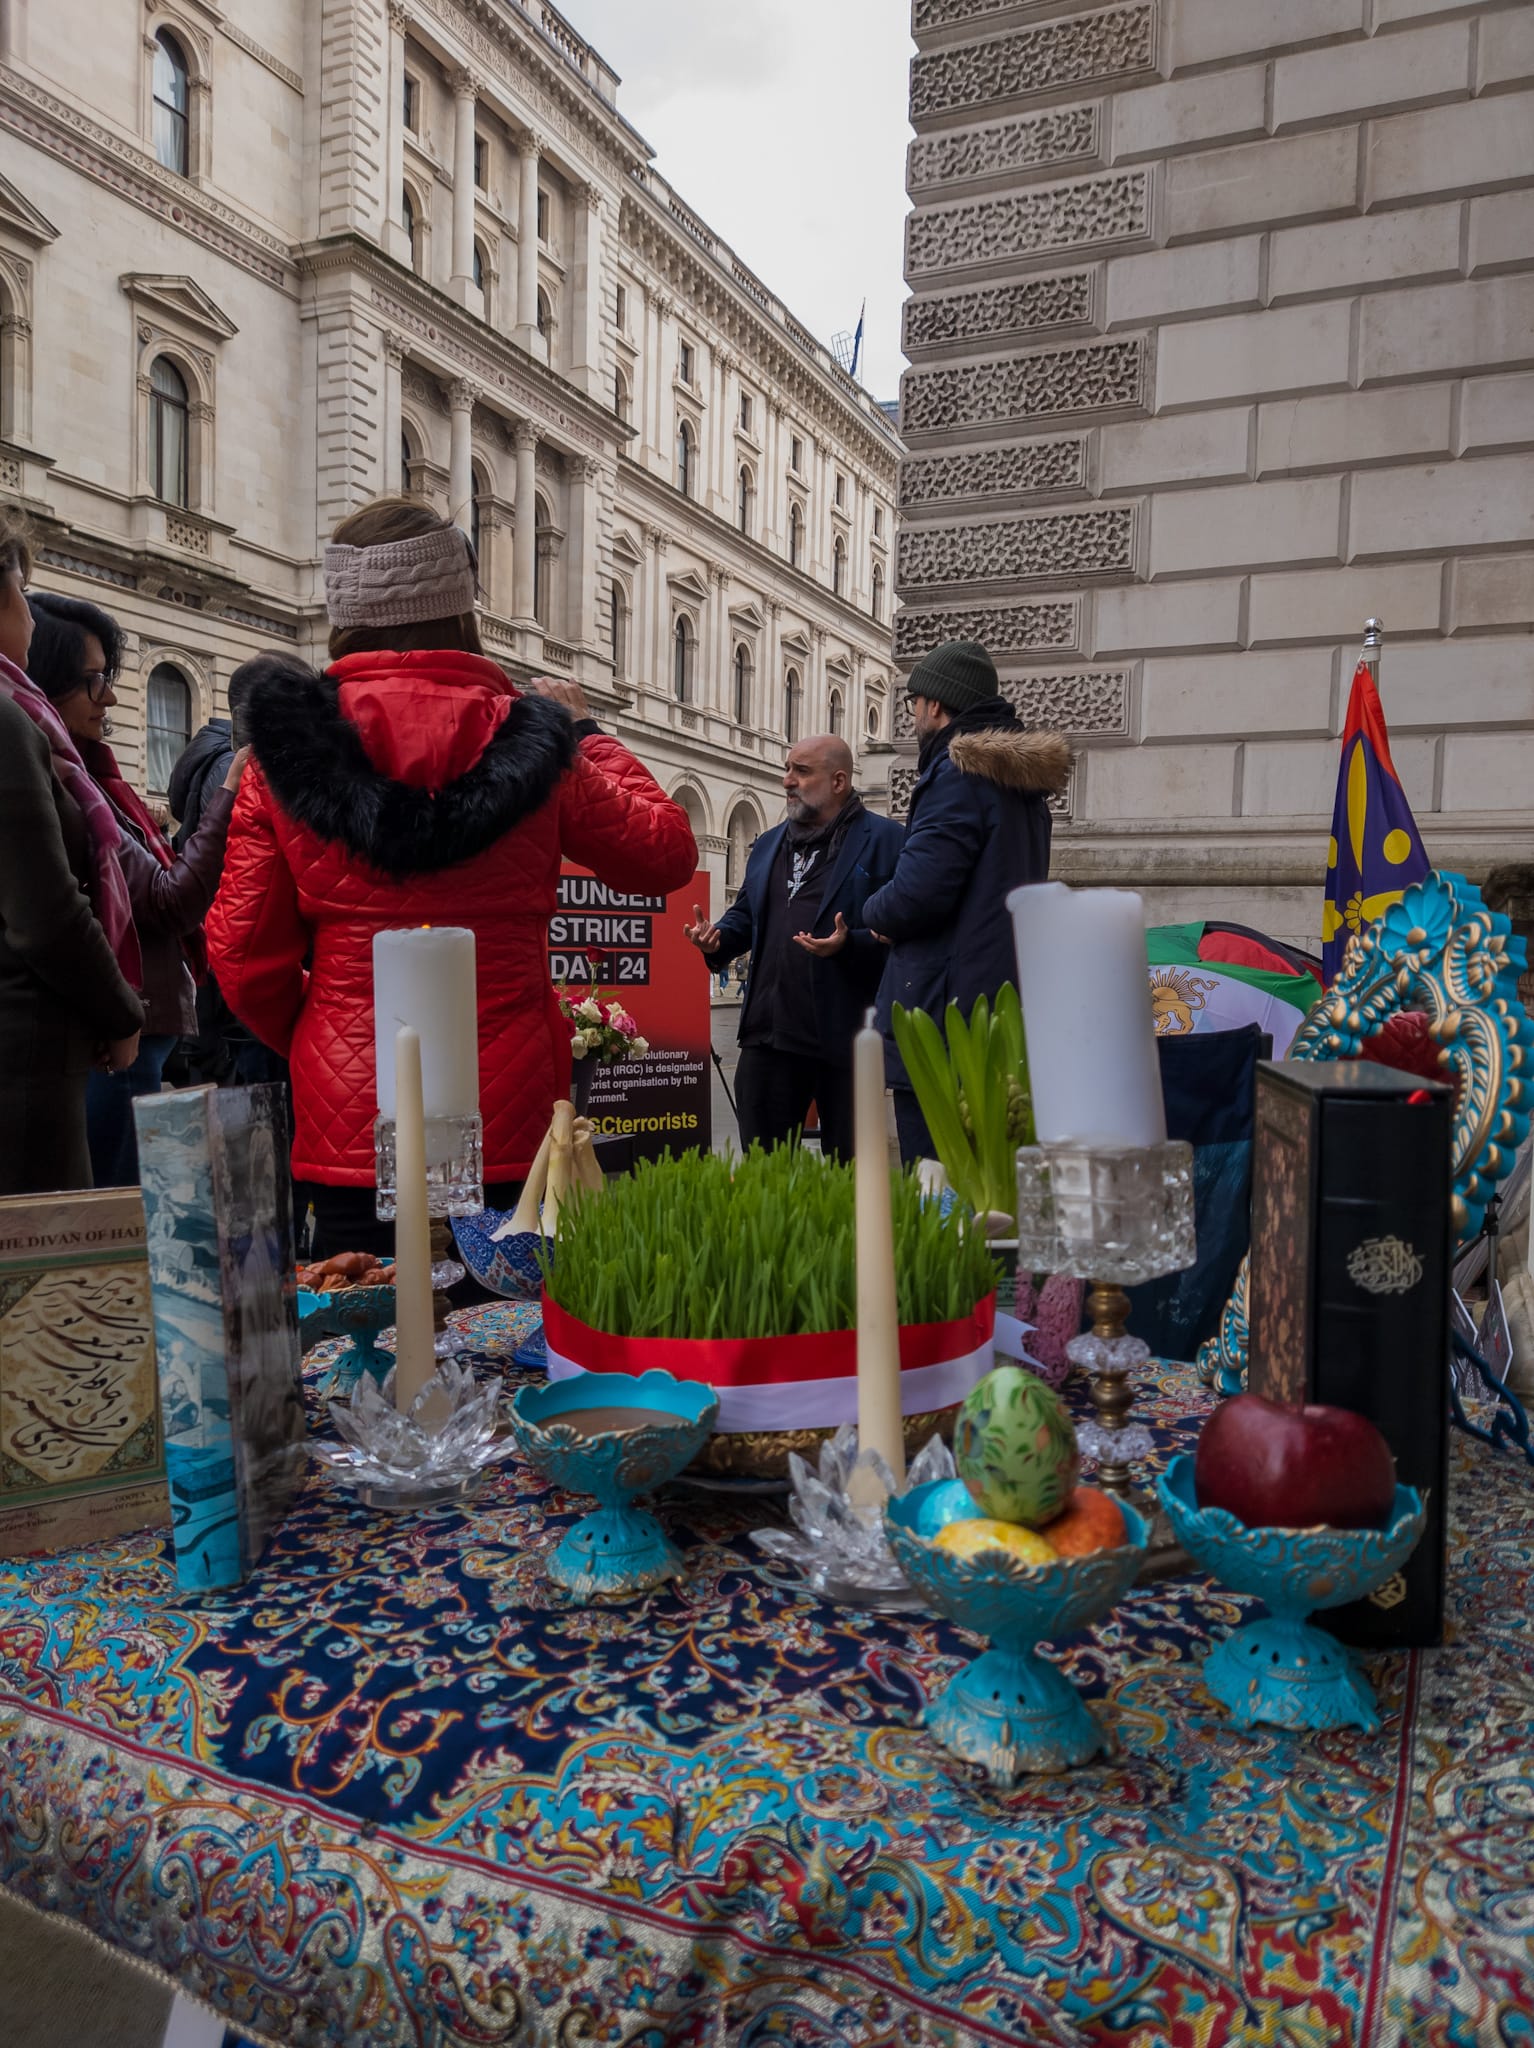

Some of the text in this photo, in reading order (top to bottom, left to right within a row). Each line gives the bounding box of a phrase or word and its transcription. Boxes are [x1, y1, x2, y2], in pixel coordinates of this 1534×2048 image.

[549, 916, 646, 943] STRIKE
[618, 956, 647, 980] 24
[628, 1050, 689, 1061] olutionary
[595, 1061, 704, 1078] rps (IRGC) is designated
[591, 1074, 698, 1090] orist organisation by the
[588, 1092, 629, 1104] ernment.
[590, 1112, 698, 1135] GCterrorists
[0, 1226, 147, 1250] HE DIVAN OF HAF
